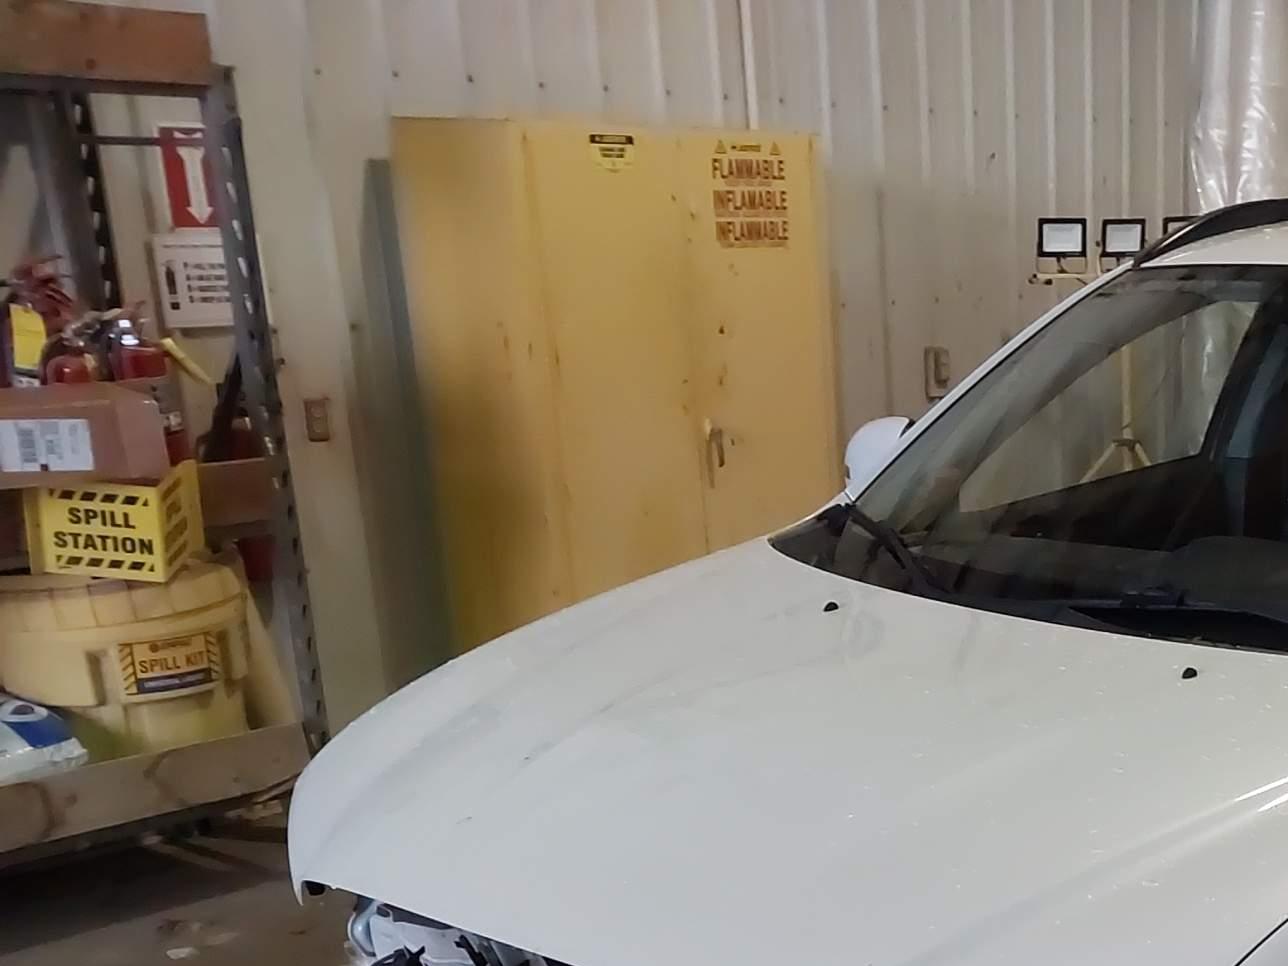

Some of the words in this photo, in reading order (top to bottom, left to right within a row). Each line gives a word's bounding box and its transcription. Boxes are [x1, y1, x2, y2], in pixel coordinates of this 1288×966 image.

[712, 158, 785, 180] FLAMMABLE
[67, 507, 136, 529] SPILL
[53, 531, 154, 555] STATION
[138, 656, 181, 674] SPILL
[185, 650, 204, 667] KIT
